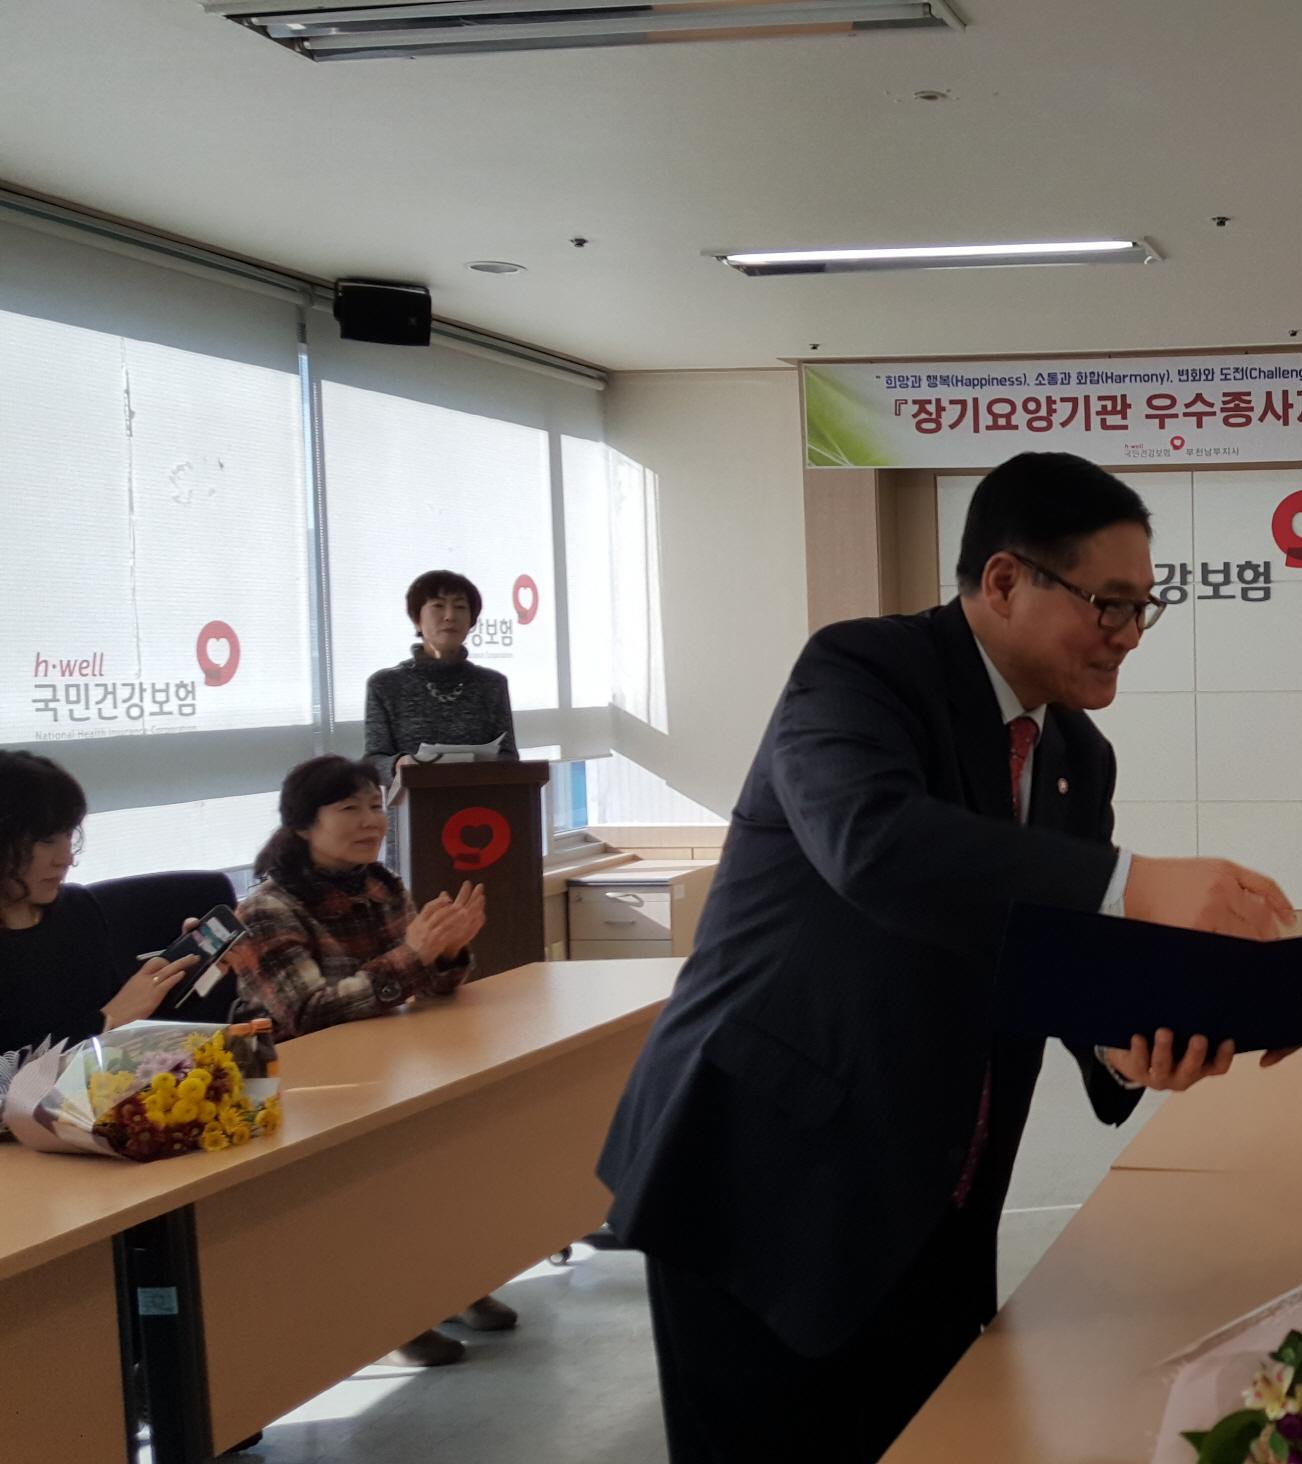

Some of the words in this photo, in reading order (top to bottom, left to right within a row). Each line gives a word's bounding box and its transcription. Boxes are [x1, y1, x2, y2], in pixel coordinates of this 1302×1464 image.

[885, 375, 922, 389] 희망과
[1034, 371, 1071, 386] 소통과
[1177, 367, 1215, 383] 변화와
[894, 393, 1132, 434] 『장기요양기관
[1185, 447, 1239, 457] 부천남부지사
[1153, 560, 1272, 605] 강보험
[467, 618, 514, 648] 강보험
[31, 680, 198, 722] 국민건강보험
